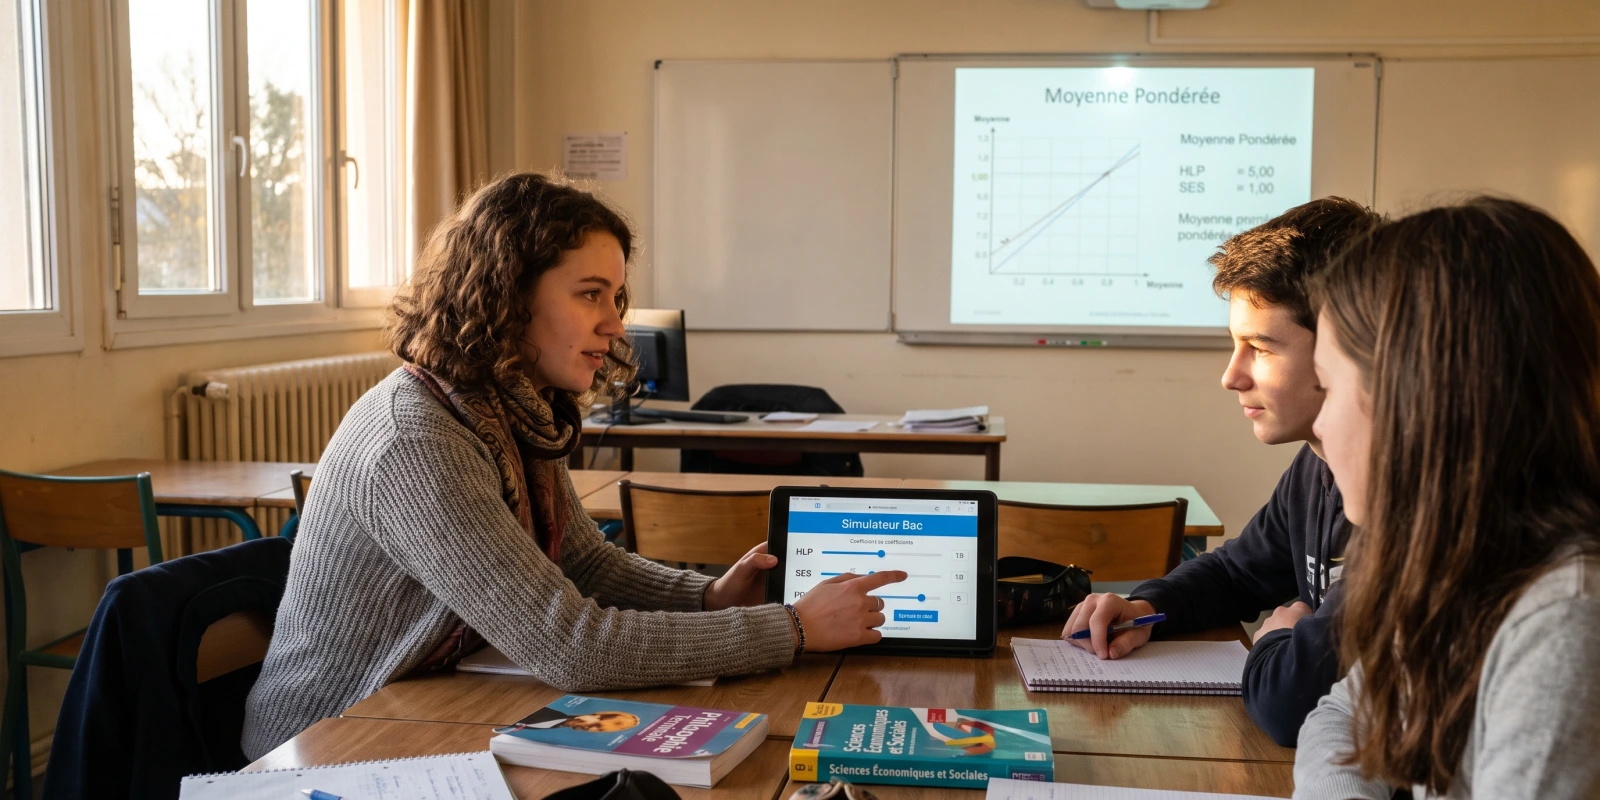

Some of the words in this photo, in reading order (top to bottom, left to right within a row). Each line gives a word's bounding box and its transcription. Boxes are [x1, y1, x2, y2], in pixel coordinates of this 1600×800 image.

[1045, 88, 1129, 107] Moyenne
[1135, 87, 1221, 104] Pondérée
[1180, 134, 1235, 147] Moyenne
[1239, 133, 1297, 145] Pondérée
[1179, 165, 1205, 176] HLP
[1248, 166, 1275, 178] 5,00
[1179, 181, 1205, 193] SES
[1249, 182, 1274, 195] 1,00
[1178, 213, 1232, 227] Moyenne
[1147, 280, 1183, 290] Moyenne
[841, 518, 900, 530] Simulateur
[902, 520, 923, 531] Bac
[796, 548, 813, 556] HLP
[795, 569, 812, 577] SES
[829, 763, 870, 776] Sciences
[873, 764, 935, 780] Économiques
[937, 769, 947, 779] et
[949, 769, 988, 781] Sociales
